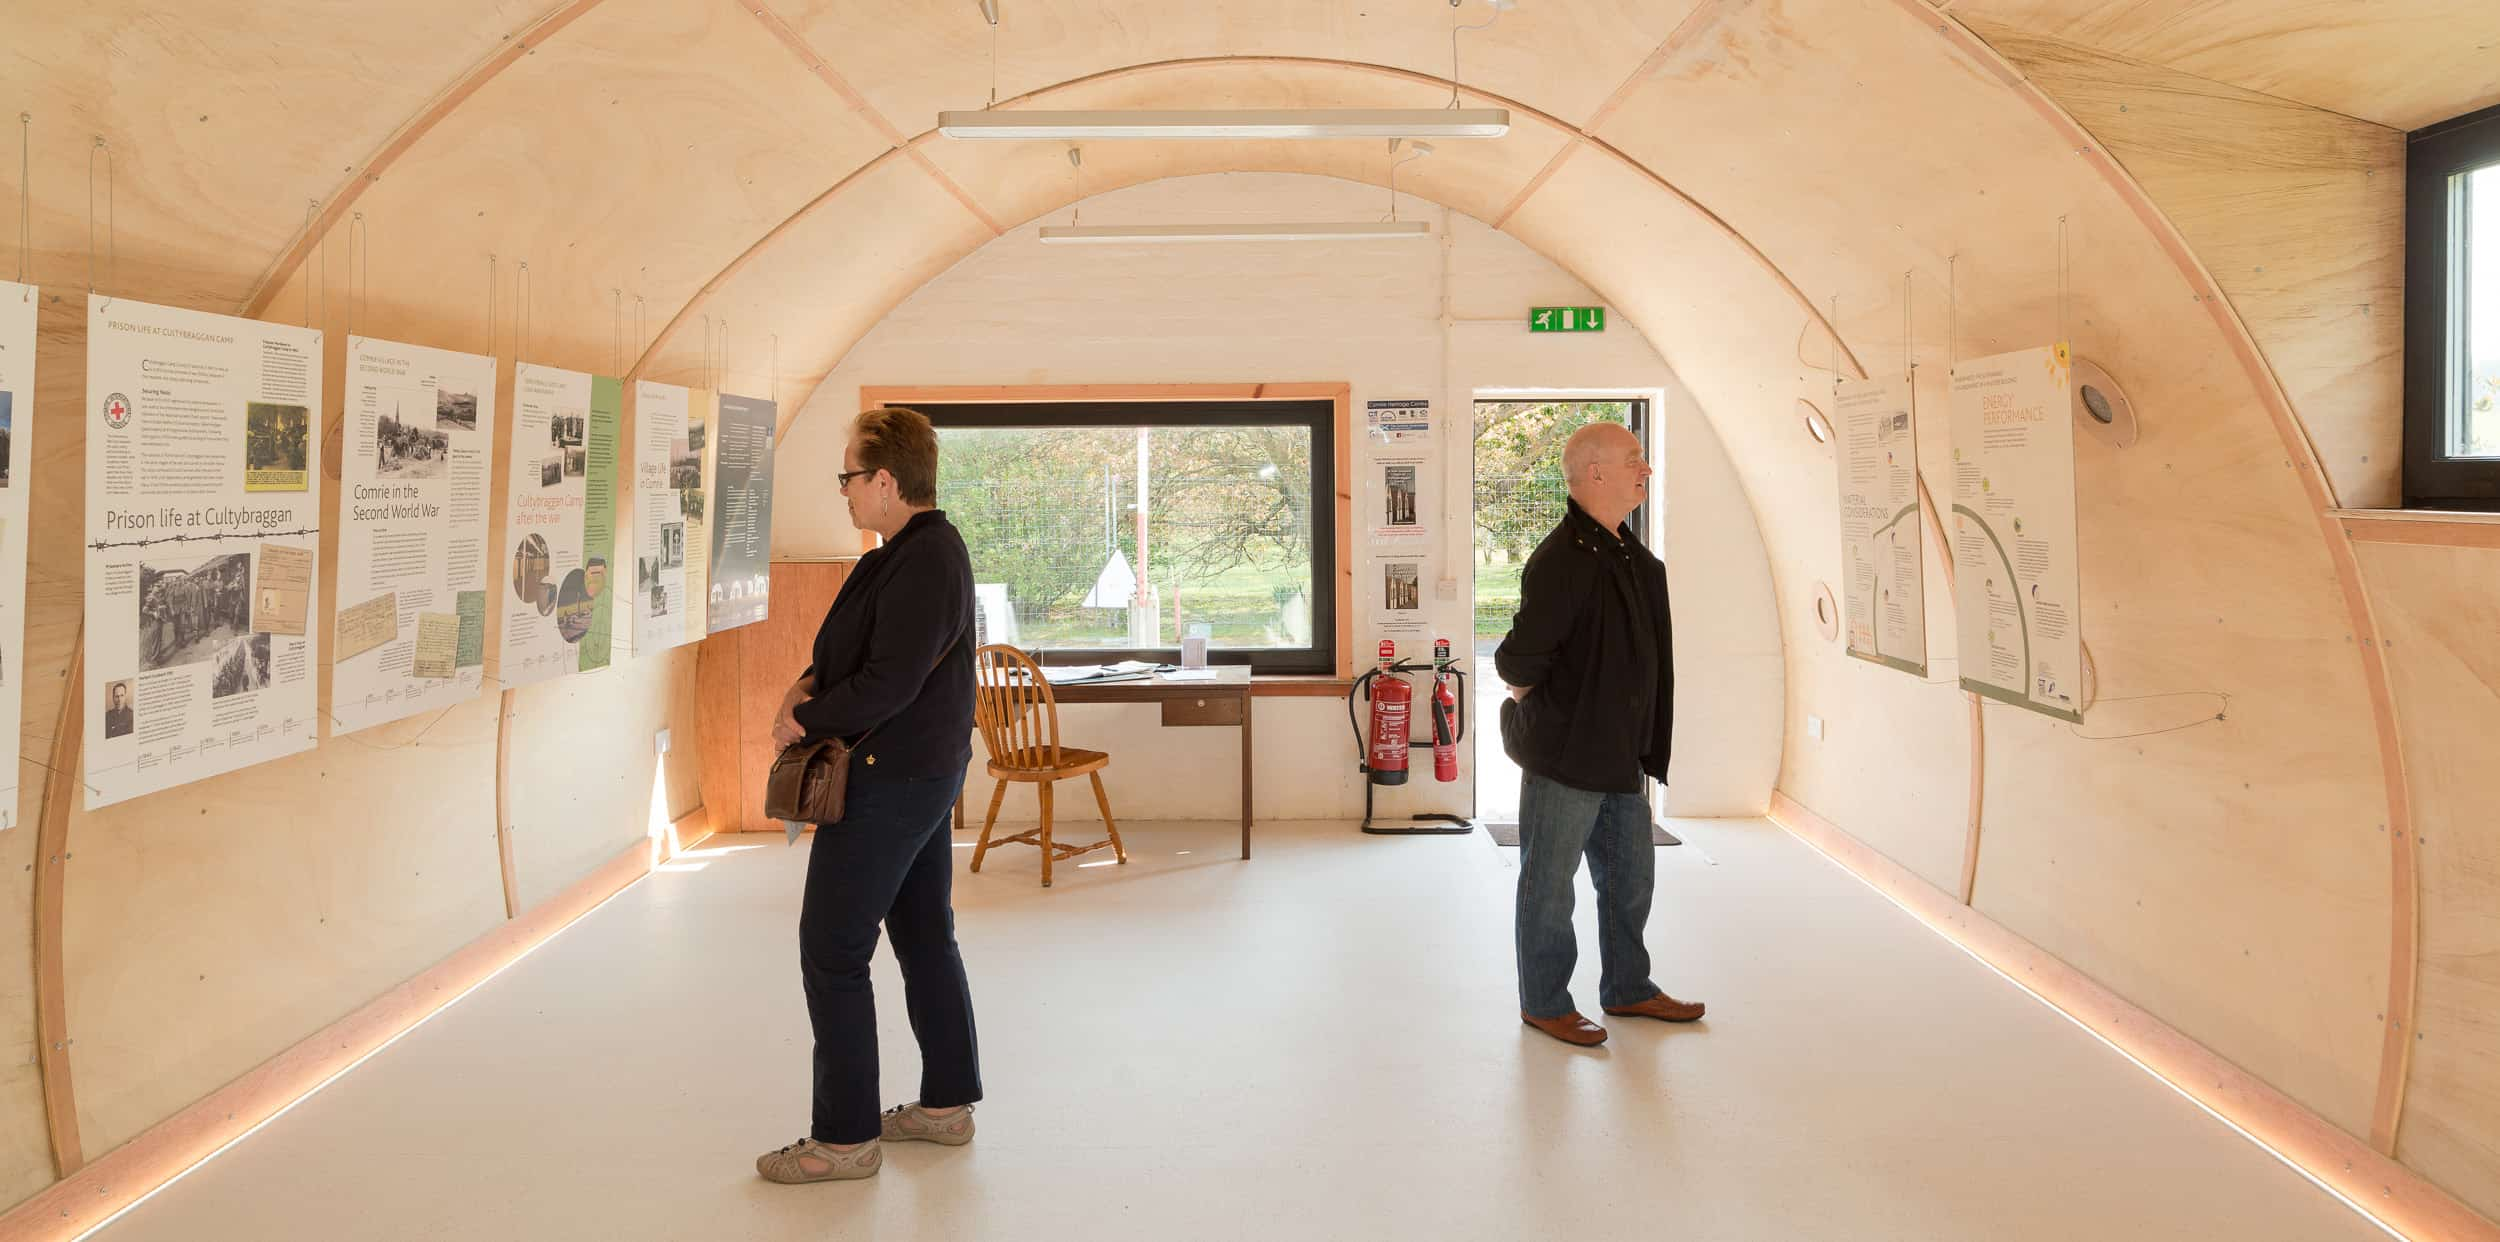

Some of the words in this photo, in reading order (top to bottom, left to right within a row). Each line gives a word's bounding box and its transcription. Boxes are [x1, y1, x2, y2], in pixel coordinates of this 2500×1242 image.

[108, 320, 136, 332] PRISON
[138, 324, 151, 334] LIFE
[152, 328, 161, 336] AT
[1984, 392, 2015, 409] ENERGY
[1984, 406, 2044, 424] PERFORMANCE
[354, 484, 390, 500] Comrie
[392, 483, 400, 498] in
[404, 482, 418, 498] the
[107, 510, 154, 529] Prison
[160, 507, 182, 528] life
[186, 510, 200, 526] at
[205, 505, 292, 530] Cultybraggan
[353, 504, 389, 520] Second
[392, 503, 420, 519] World
[422, 503, 440, 518] War
[516, 512, 534, 525] after
